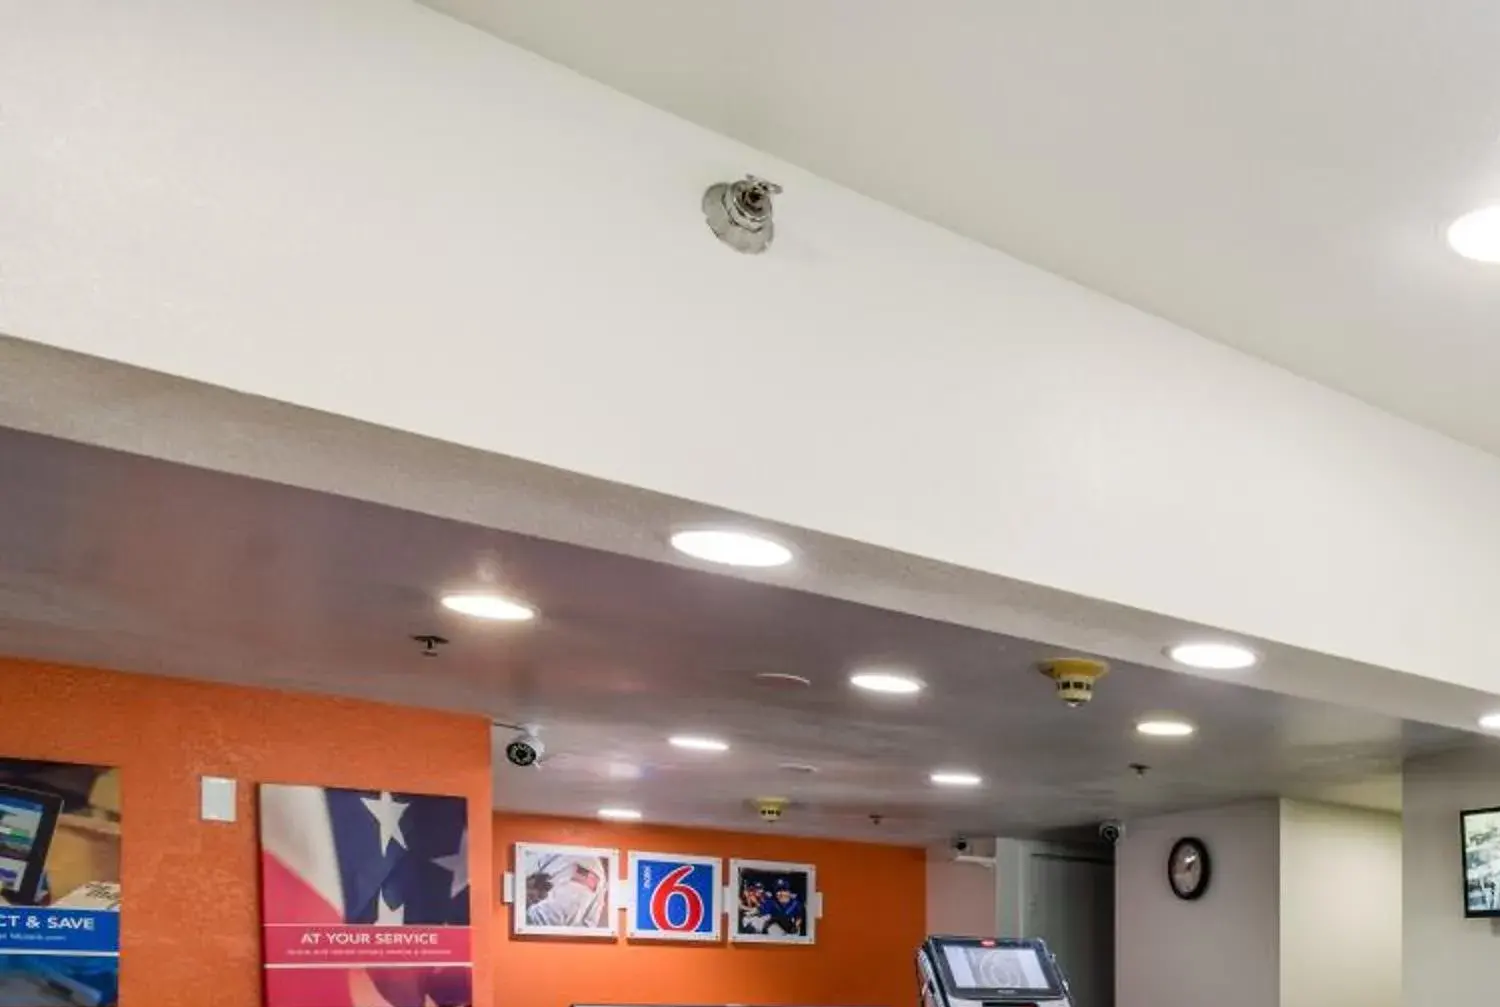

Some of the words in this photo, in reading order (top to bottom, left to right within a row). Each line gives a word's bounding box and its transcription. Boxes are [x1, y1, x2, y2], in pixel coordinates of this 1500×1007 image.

[649, 864, 704, 934] 6
[25, 915, 41, 929] &
[47, 916, 96, 931] SAVE
[301, 933, 321, 945] AT
[325, 933, 371, 945] YOUR
[374, 933, 439, 946] SERVICE
